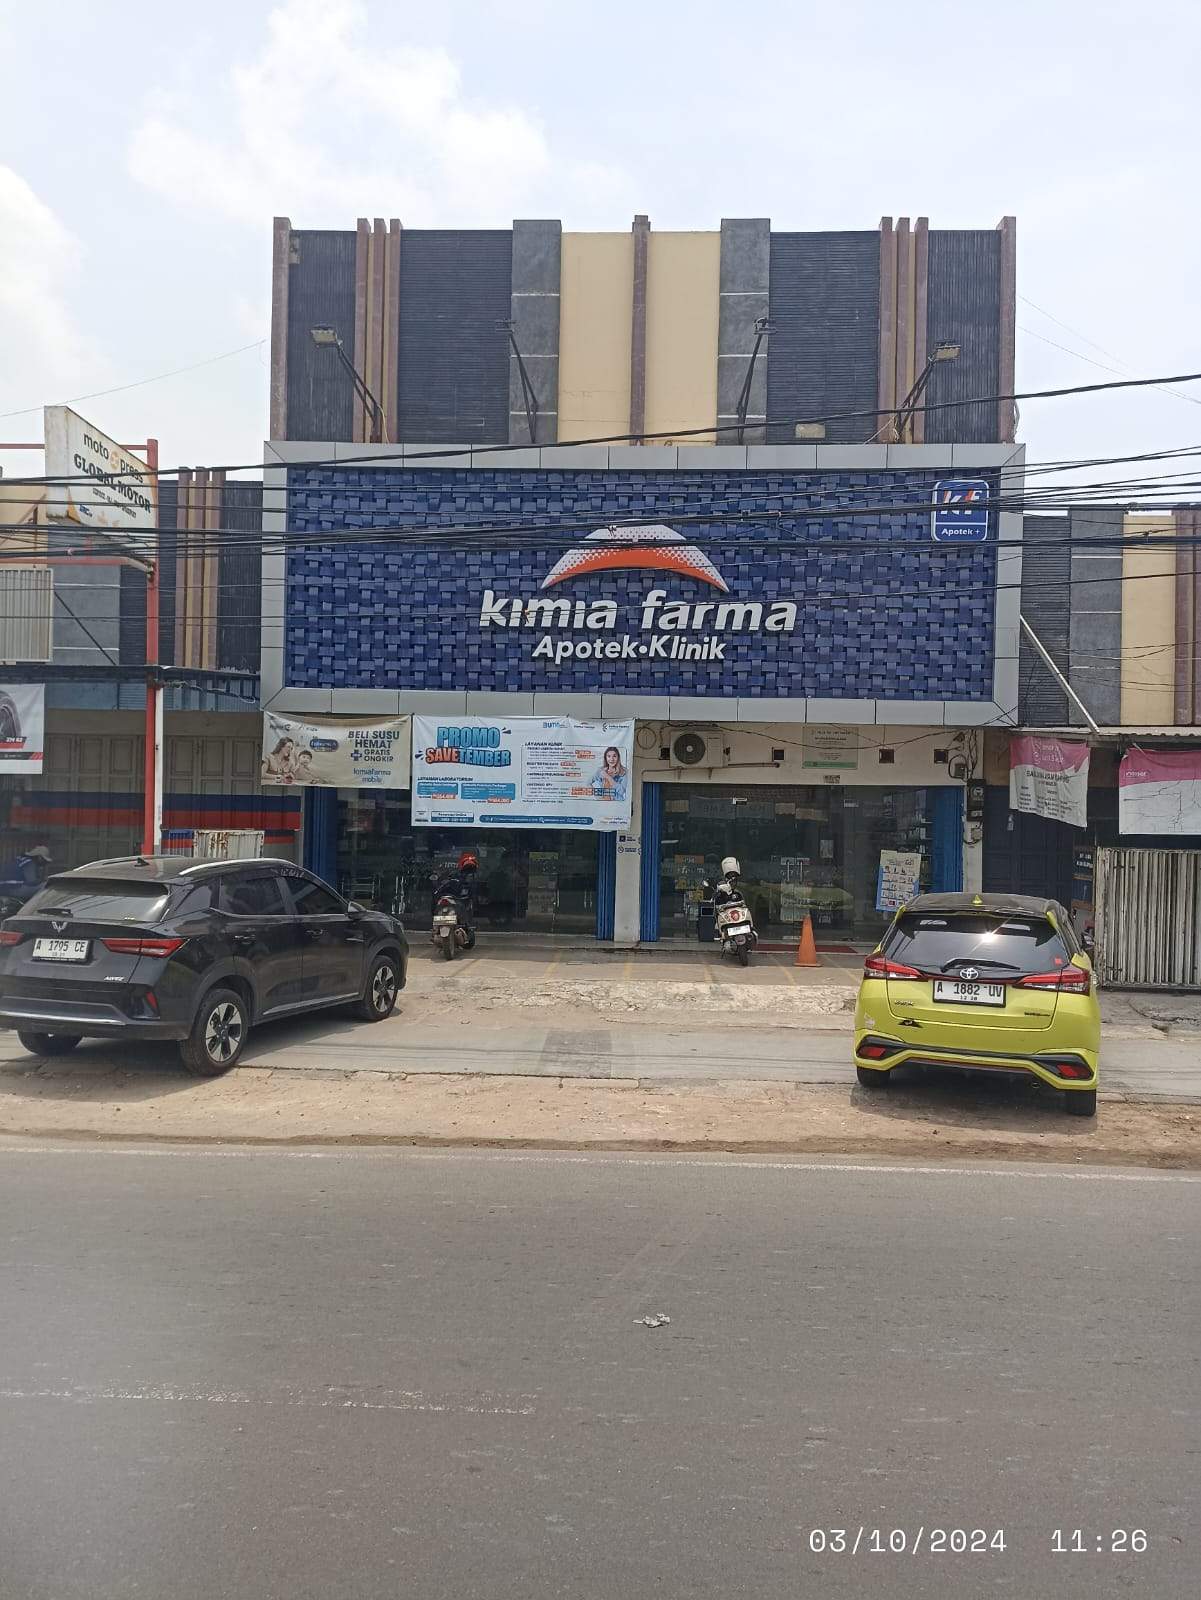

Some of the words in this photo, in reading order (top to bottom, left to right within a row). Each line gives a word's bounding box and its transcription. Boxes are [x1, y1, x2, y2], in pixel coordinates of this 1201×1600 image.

[83, 433, 110, 460] moto
[119, 458, 144, 484] press
[73, 453, 118, 492] GLOBAL
[116, 480, 152, 514] MOTOR
[941, 528, 974, 537] Apotek
[479, 590, 617, 629] kimia
[641, 589, 798, 631] farma
[348, 730, 369, 739] BELI
[372, 730, 400, 740] SUSU
[437, 726, 501, 749] PROMO
[354, 739, 393, 749] HEMAT
[363, 748, 391, 756] GRATIS
[425, 747, 512, 767] SAVETEMBER
[36, 940, 42, 951] A
[48, 940, 70, 952] 1795
[74, 941, 87, 953] CE
[936, 981, 943, 993] A
[953, 982, 980, 996] 1882
[988, 985, 1003, 998] UV
